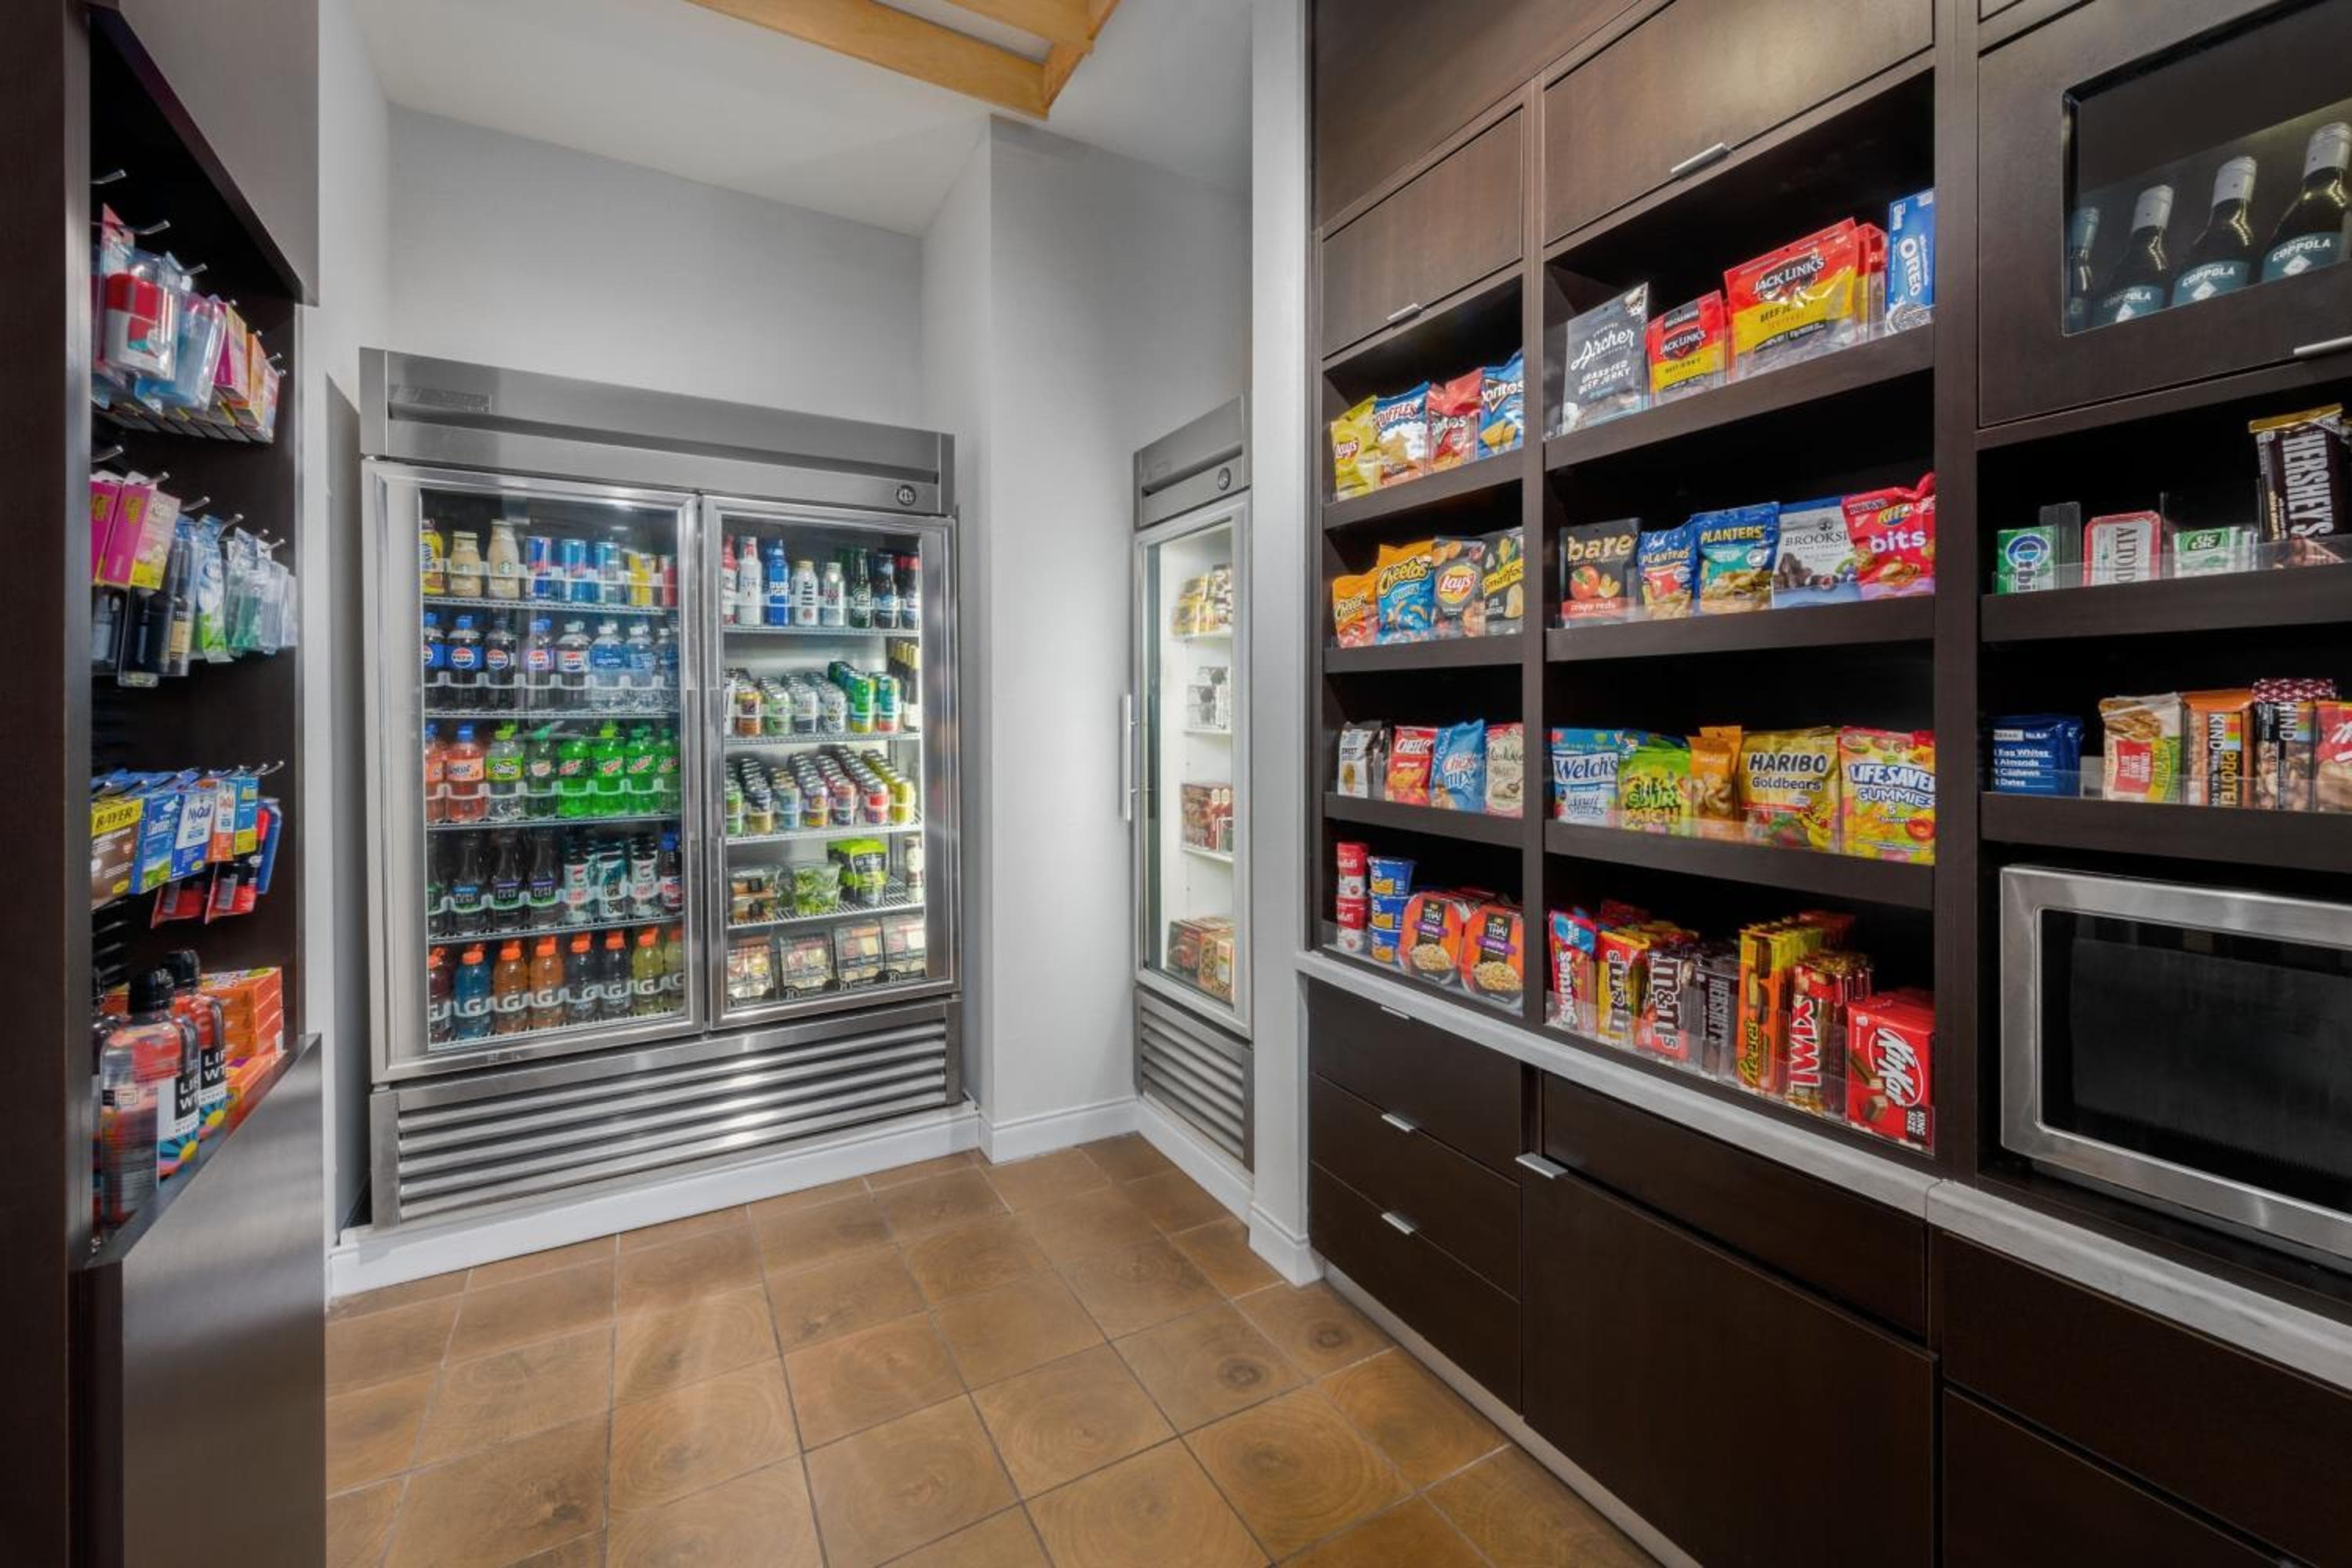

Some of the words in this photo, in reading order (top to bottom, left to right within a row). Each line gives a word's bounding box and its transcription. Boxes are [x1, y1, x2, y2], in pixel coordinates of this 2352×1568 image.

[2272, 238, 2332, 263] COPPOLA
[1785, 256, 1826, 281] LINK'S
[1899, 237, 1922, 297] OREO
[2182, 266, 2235, 288] COPPOLA
[1570, 328, 1635, 371] Archer
[1375, 401, 1419, 426] RUFFLES
[2282, 431, 2334, 537] HERSHEY'S
[1700, 526, 1764, 545] PLANTERS
[1784, 530, 1848, 547] BROOKSI
[1870, 530, 1926, 554] bits
[1567, 533, 1633, 562] bare
[1641, 549, 1690, 565] PLANTERS
[2116, 526, 2138, 583] ALTOID
[1378, 557, 1429, 596] Cheetos
[1441, 572, 1475, 594] Lay's
[2209, 713, 2225, 750] KIND
[2280, 702, 2296, 741] KIND
[1555, 757, 1618, 779] Welch's
[1749, 753, 1828, 774] HARIBO
[2000, 758, 2039, 767] Almonds
[1751, 776, 1822, 791] Goldbears
[2220, 751, 2238, 807] PROTEI
[1857, 788, 1933, 808] GUMMIES
[464, 997, 481, 1014] G
[536, 989, 553, 1004] G
[204, 1050, 227, 1068] LIF
[204, 1067, 227, 1083] WT
